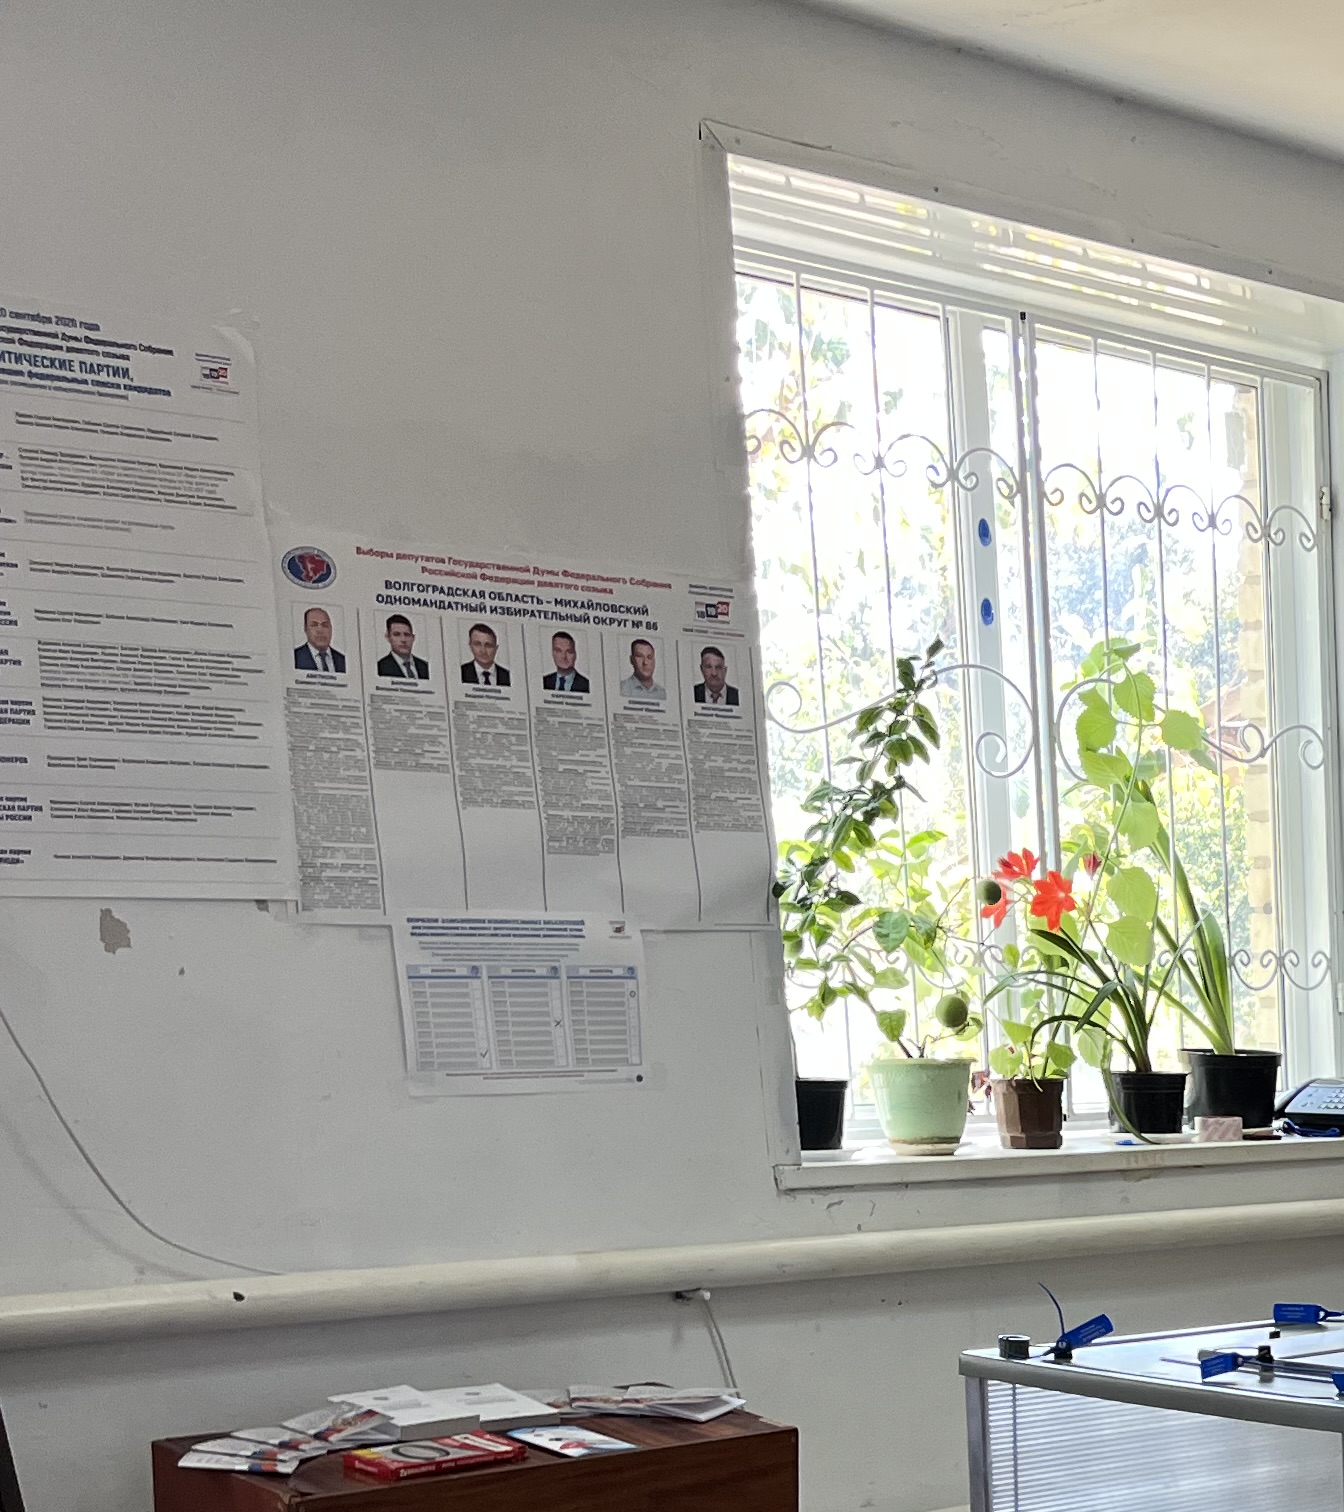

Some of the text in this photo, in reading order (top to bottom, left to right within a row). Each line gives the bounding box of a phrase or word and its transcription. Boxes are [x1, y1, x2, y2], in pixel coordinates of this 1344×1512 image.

[79, 361, 134, 382] ПАРТИИ,
[375, 592, 487, 616] ОДНОМАНДАТНЫЙ
[489, 603, 592, 626] ИЗБИРАТЕЛЬНЫЙ
[592, 614, 630, 628] ОКРУГ
[385, 579, 486, 601] ВОЛГОГРАДСКАЯ
[488, 590, 544, 606] ОБЛАСТЬ
[554, 597, 649, 617] МИХАЙЛОВСКИЙ
